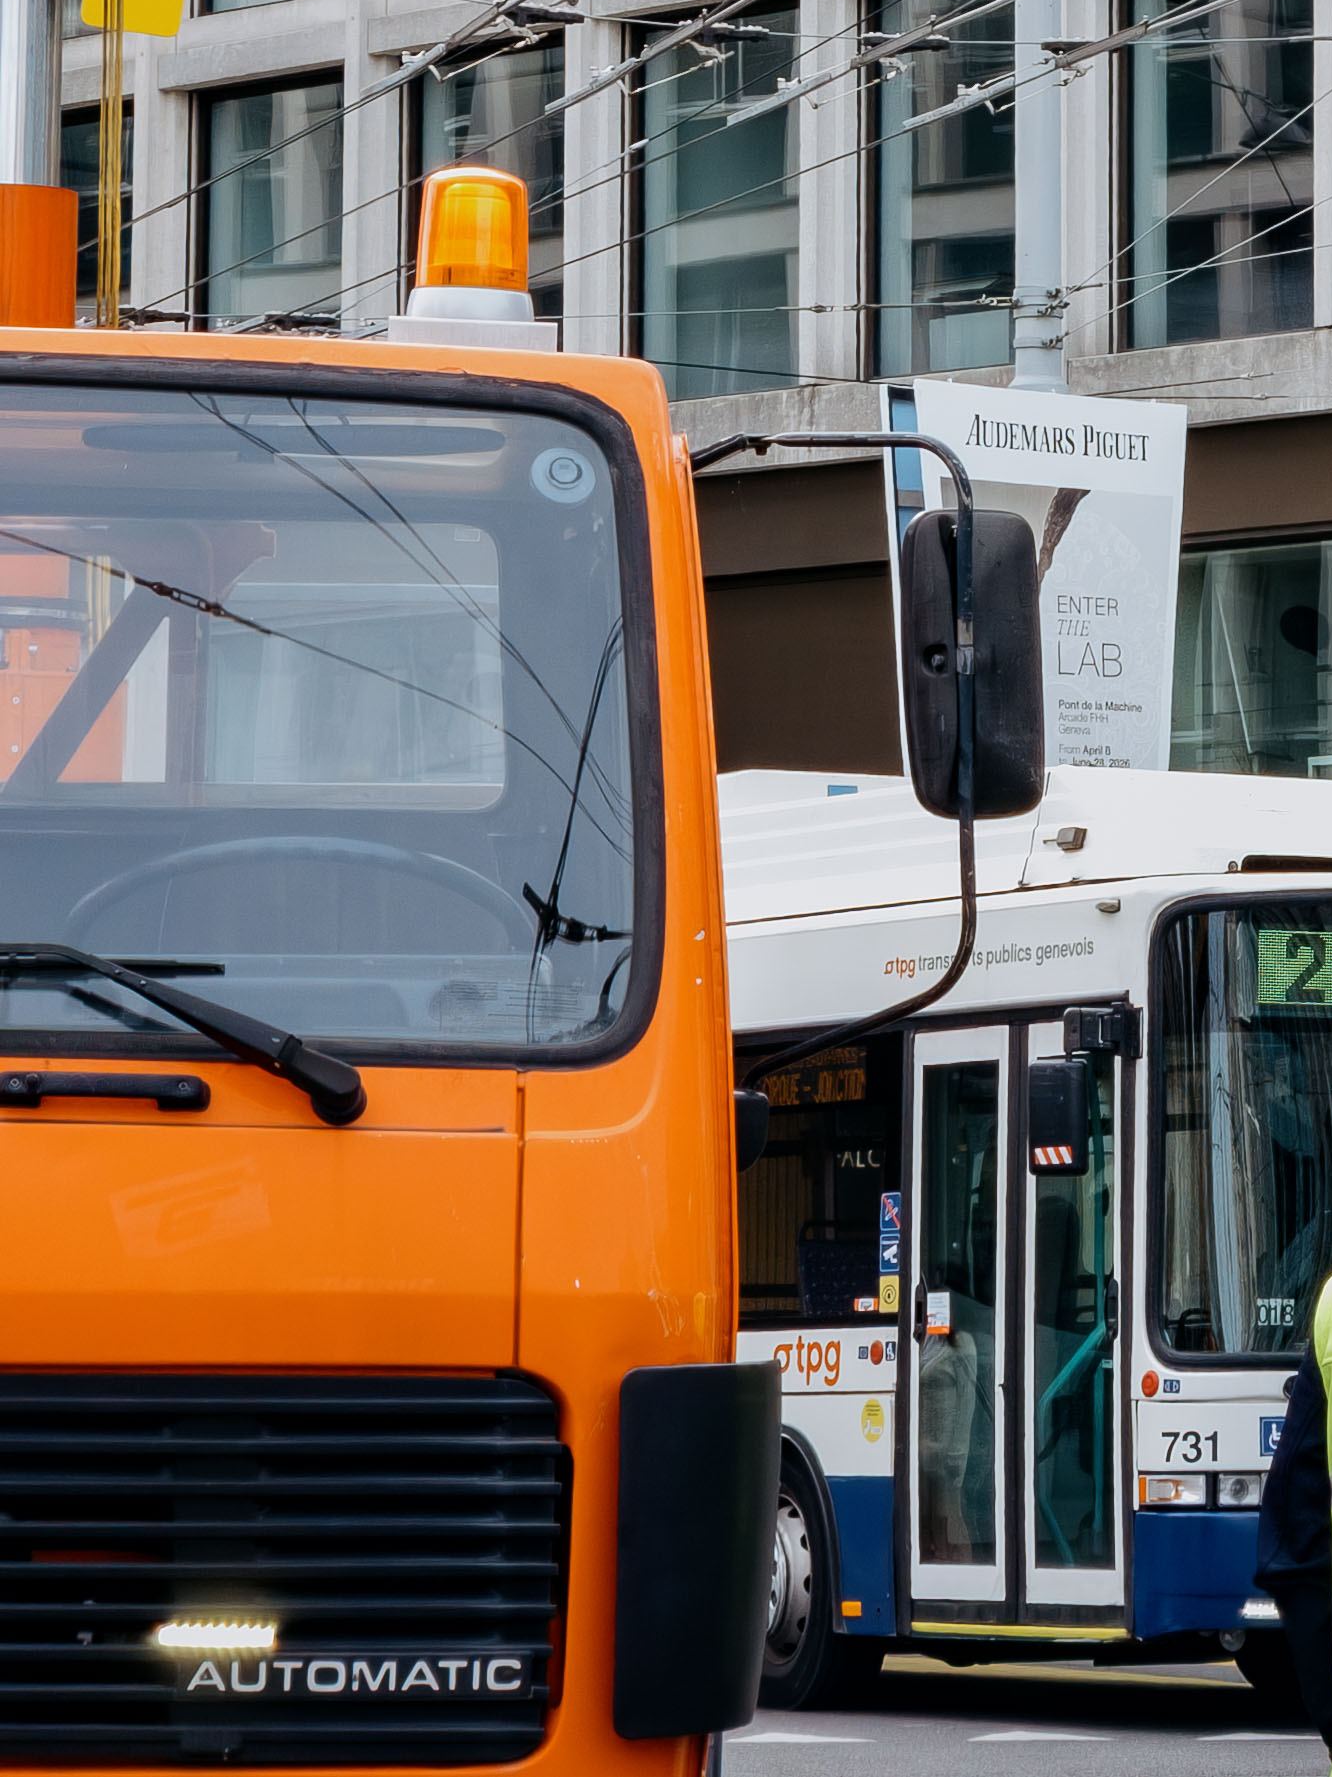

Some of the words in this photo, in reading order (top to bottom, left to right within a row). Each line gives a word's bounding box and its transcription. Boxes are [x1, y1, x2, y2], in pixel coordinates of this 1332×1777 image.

[966, 413, 1075, 456] AUDEMARS
[1083, 424, 1150, 462] PIGUET
[1057, 595, 1119, 617] ENTER
[1057, 619, 1090, 637] THE
[1057, 642, 1123, 678] LAB
[1058, 699, 1080, 710] Pont
[1095, 701, 1103, 711] la
[918, 951, 983, 972] transts
[986, 940, 1032, 970] publics
[1035, 937, 1094, 966] genevois
[1284, 932, 1327, 1003] 2
[1161, 1430, 1220, 1464] 731
[186, 1659, 523, 1693] AUTOMATIC
